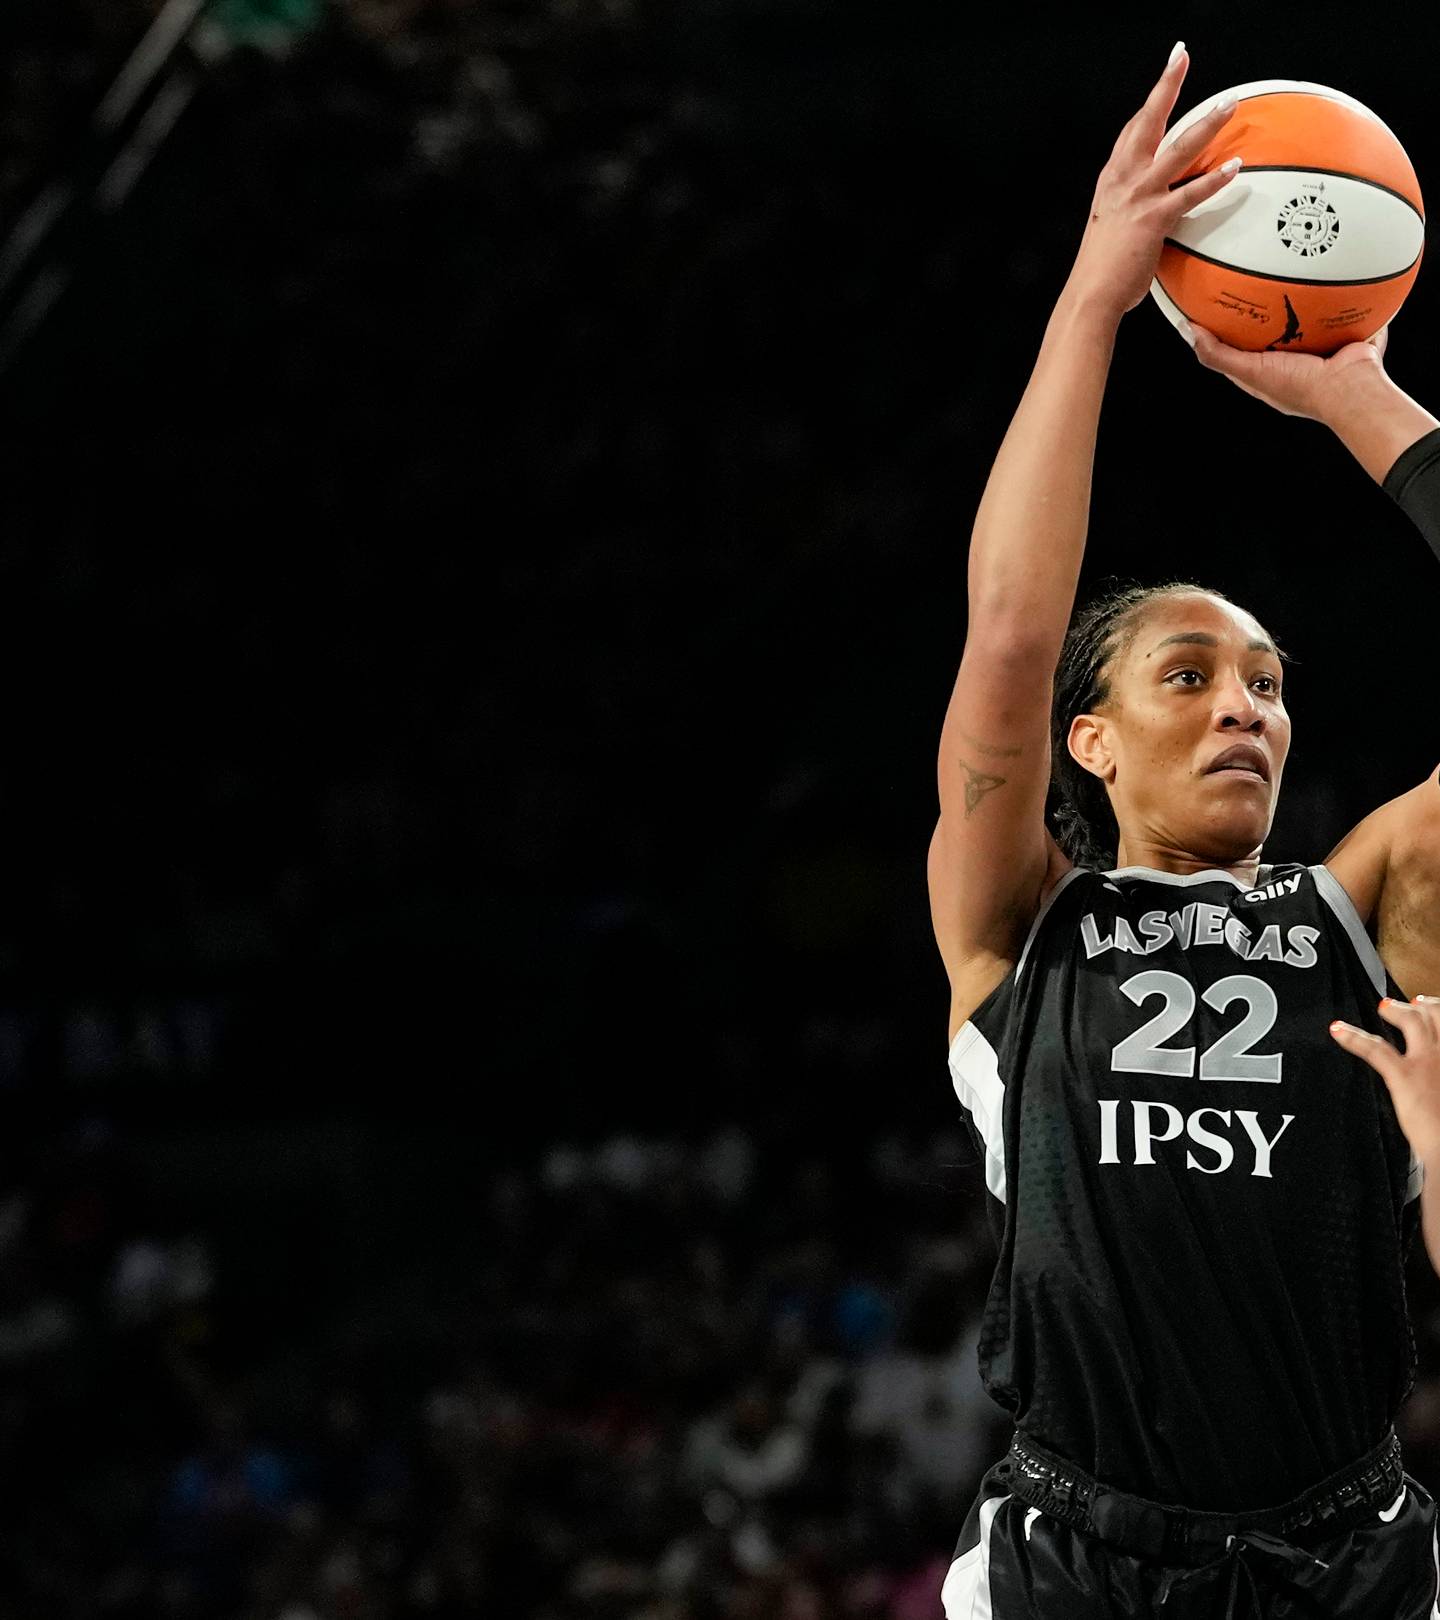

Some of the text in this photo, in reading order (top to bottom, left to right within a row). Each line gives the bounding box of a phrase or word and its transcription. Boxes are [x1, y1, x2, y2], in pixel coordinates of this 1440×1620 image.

[1244, 872, 1302, 903] ally
[1110, 969, 1283, 1084] 22
[1097, 1099, 1296, 1178] IPSY
